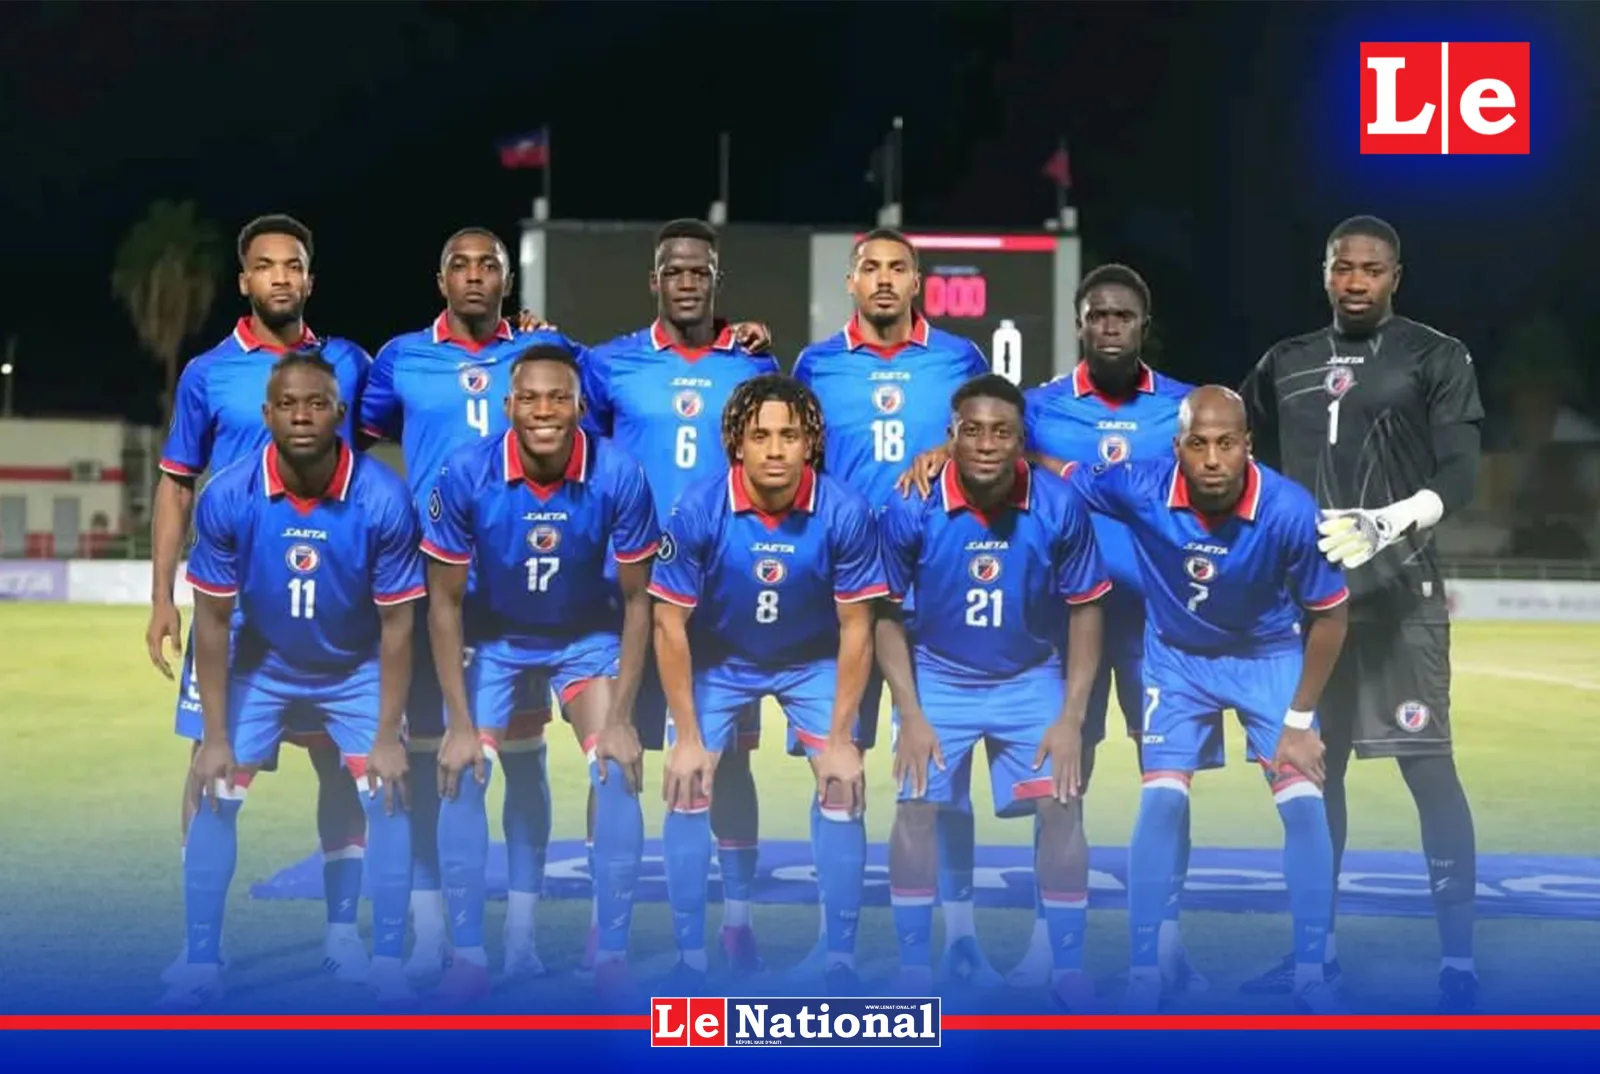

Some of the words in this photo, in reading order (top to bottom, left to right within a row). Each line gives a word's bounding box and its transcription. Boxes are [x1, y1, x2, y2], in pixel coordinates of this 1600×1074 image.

[466, 398, 488, 438] 4
[1327, 400, 1340, 445] 1
[675, 425, 697, 469] 6
[871, 419, 905, 462] 18
[525, 557, 560, 592] 17
[287, 577, 316, 619] 11
[755, 590, 779, 624] 8
[965, 588, 1004, 627] 21
[1187, 581, 1209, 612] 7
[1145, 687, 1160, 731] 7
